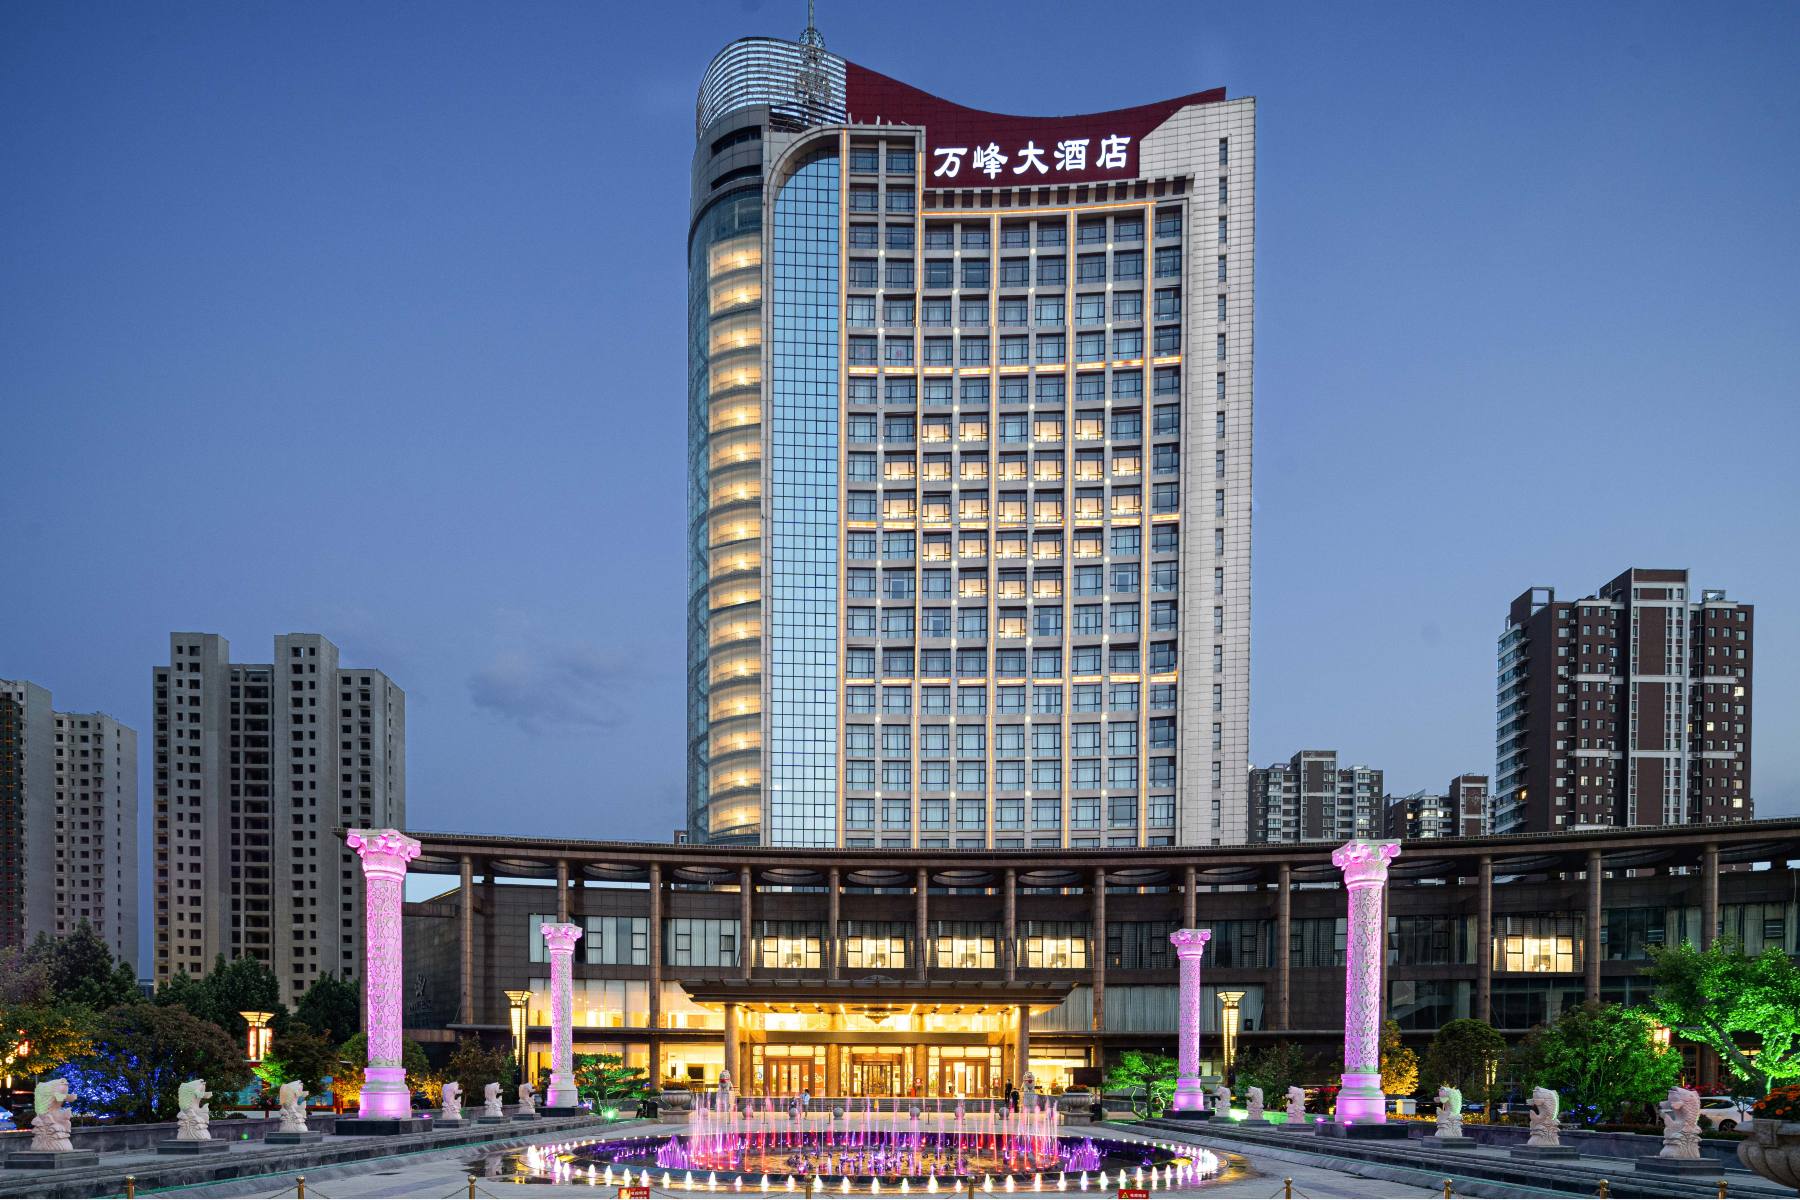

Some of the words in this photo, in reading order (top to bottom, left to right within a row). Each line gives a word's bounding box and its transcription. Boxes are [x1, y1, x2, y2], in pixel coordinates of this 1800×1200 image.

[933, 134, 1131, 180] 万峰大酒店
